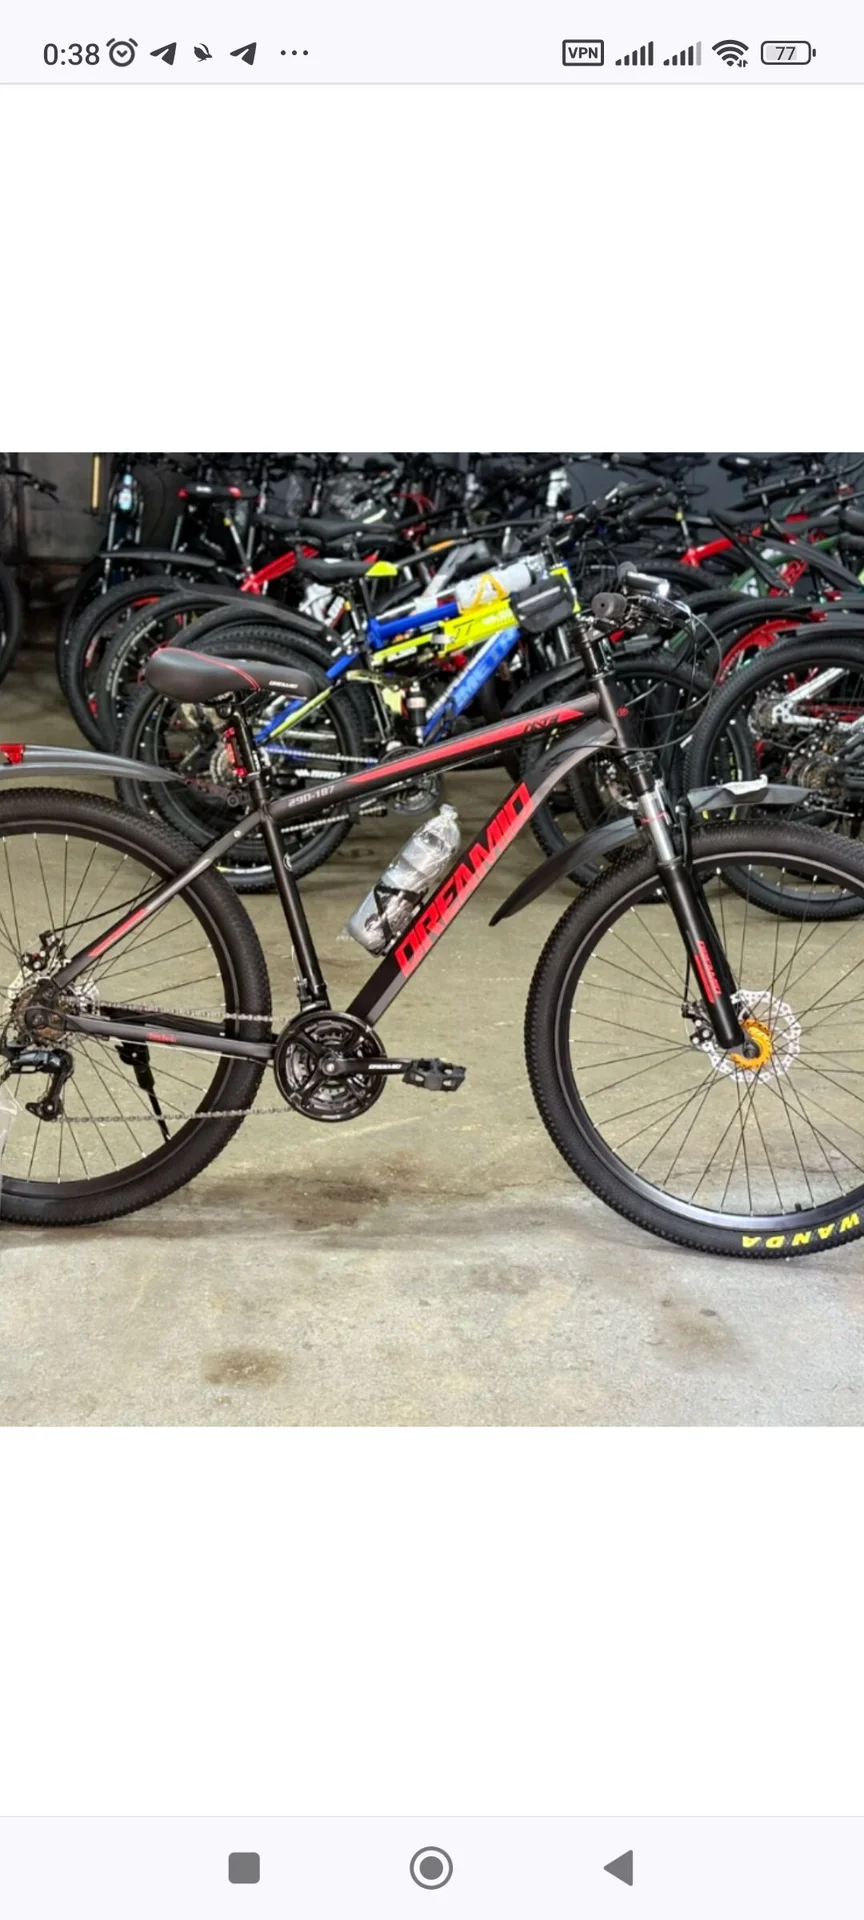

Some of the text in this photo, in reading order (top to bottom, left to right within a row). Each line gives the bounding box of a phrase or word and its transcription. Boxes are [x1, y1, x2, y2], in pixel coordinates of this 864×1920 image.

[43, 42, 100, 66] 0:38
[567, 46, 599, 59] VPN
[775, 46, 796, 61] 77
[394, 781, 535, 978] DREAMIO
[742, 1212, 860, 1249] WANDA
